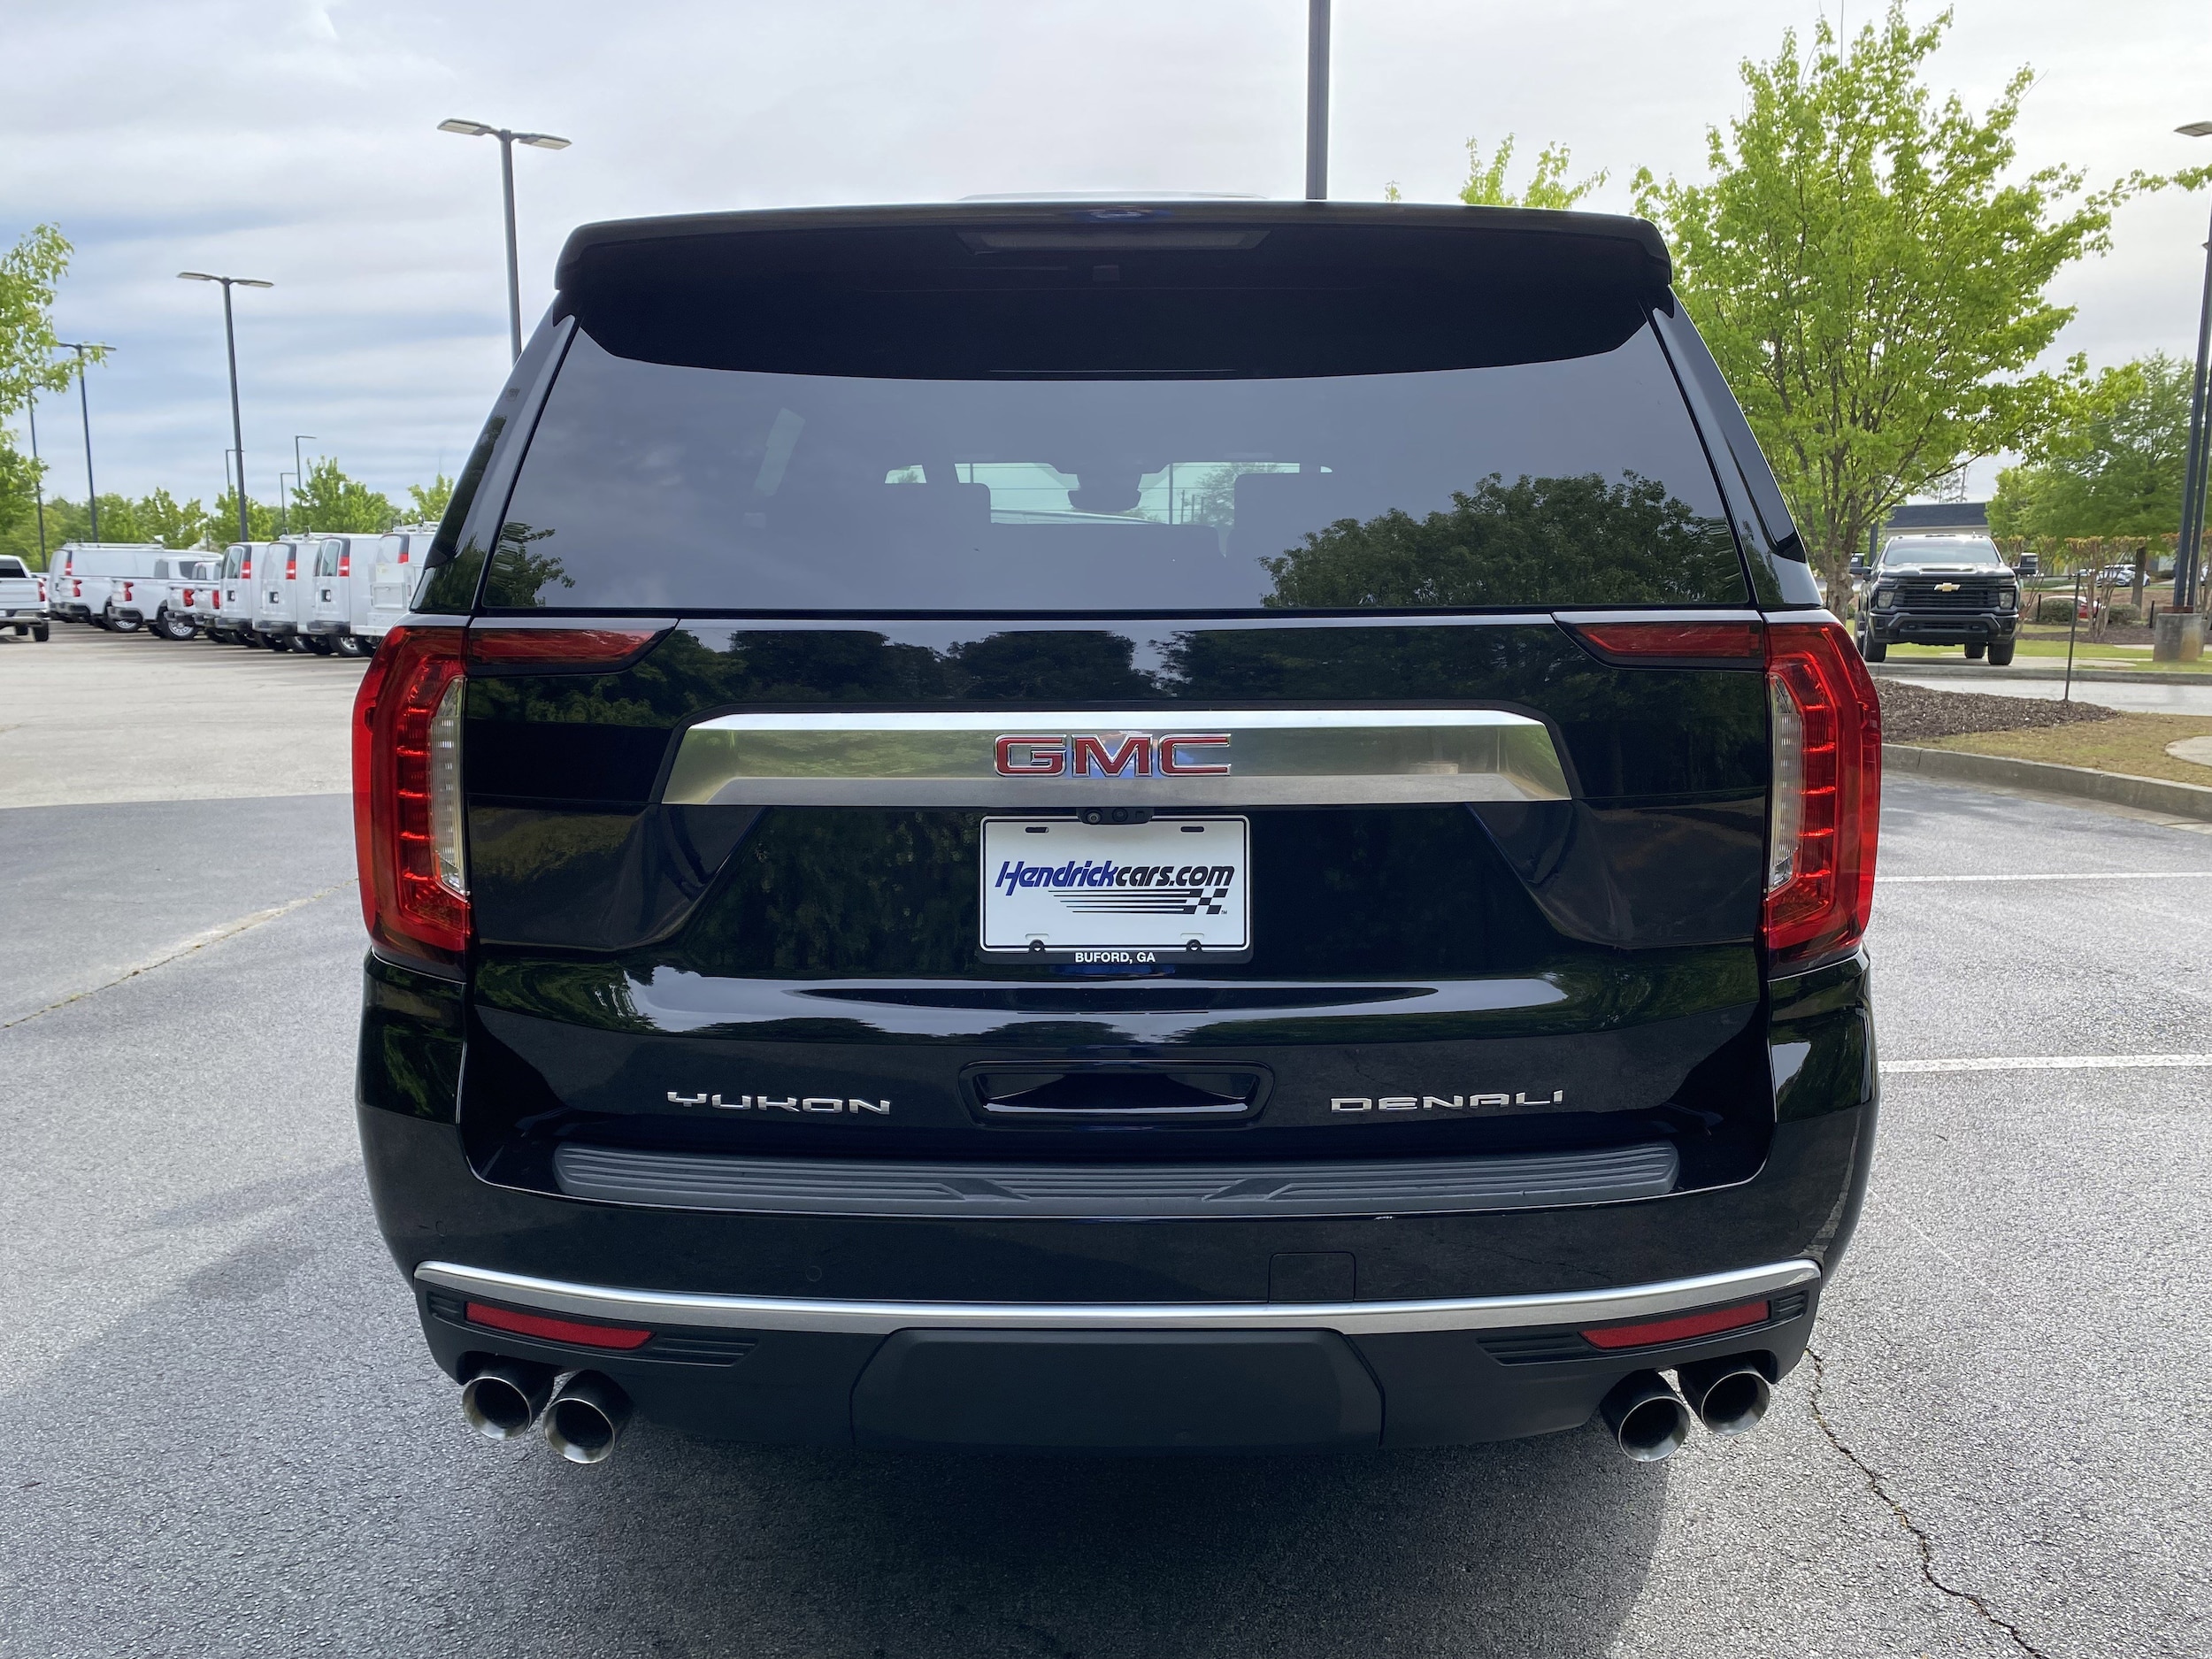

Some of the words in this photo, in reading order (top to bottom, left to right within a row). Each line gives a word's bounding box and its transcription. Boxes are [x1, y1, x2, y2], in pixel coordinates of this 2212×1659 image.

[995, 733, 1232, 777] GMC
[995, 860, 1235, 895] Hendrickcars.com
[1075, 952, 1133, 964] BUFORD,
[1136, 952, 1156, 964] GA
[667, 1091, 890, 1115] YUKON
[1331, 1090, 1563, 1112] DENALI
